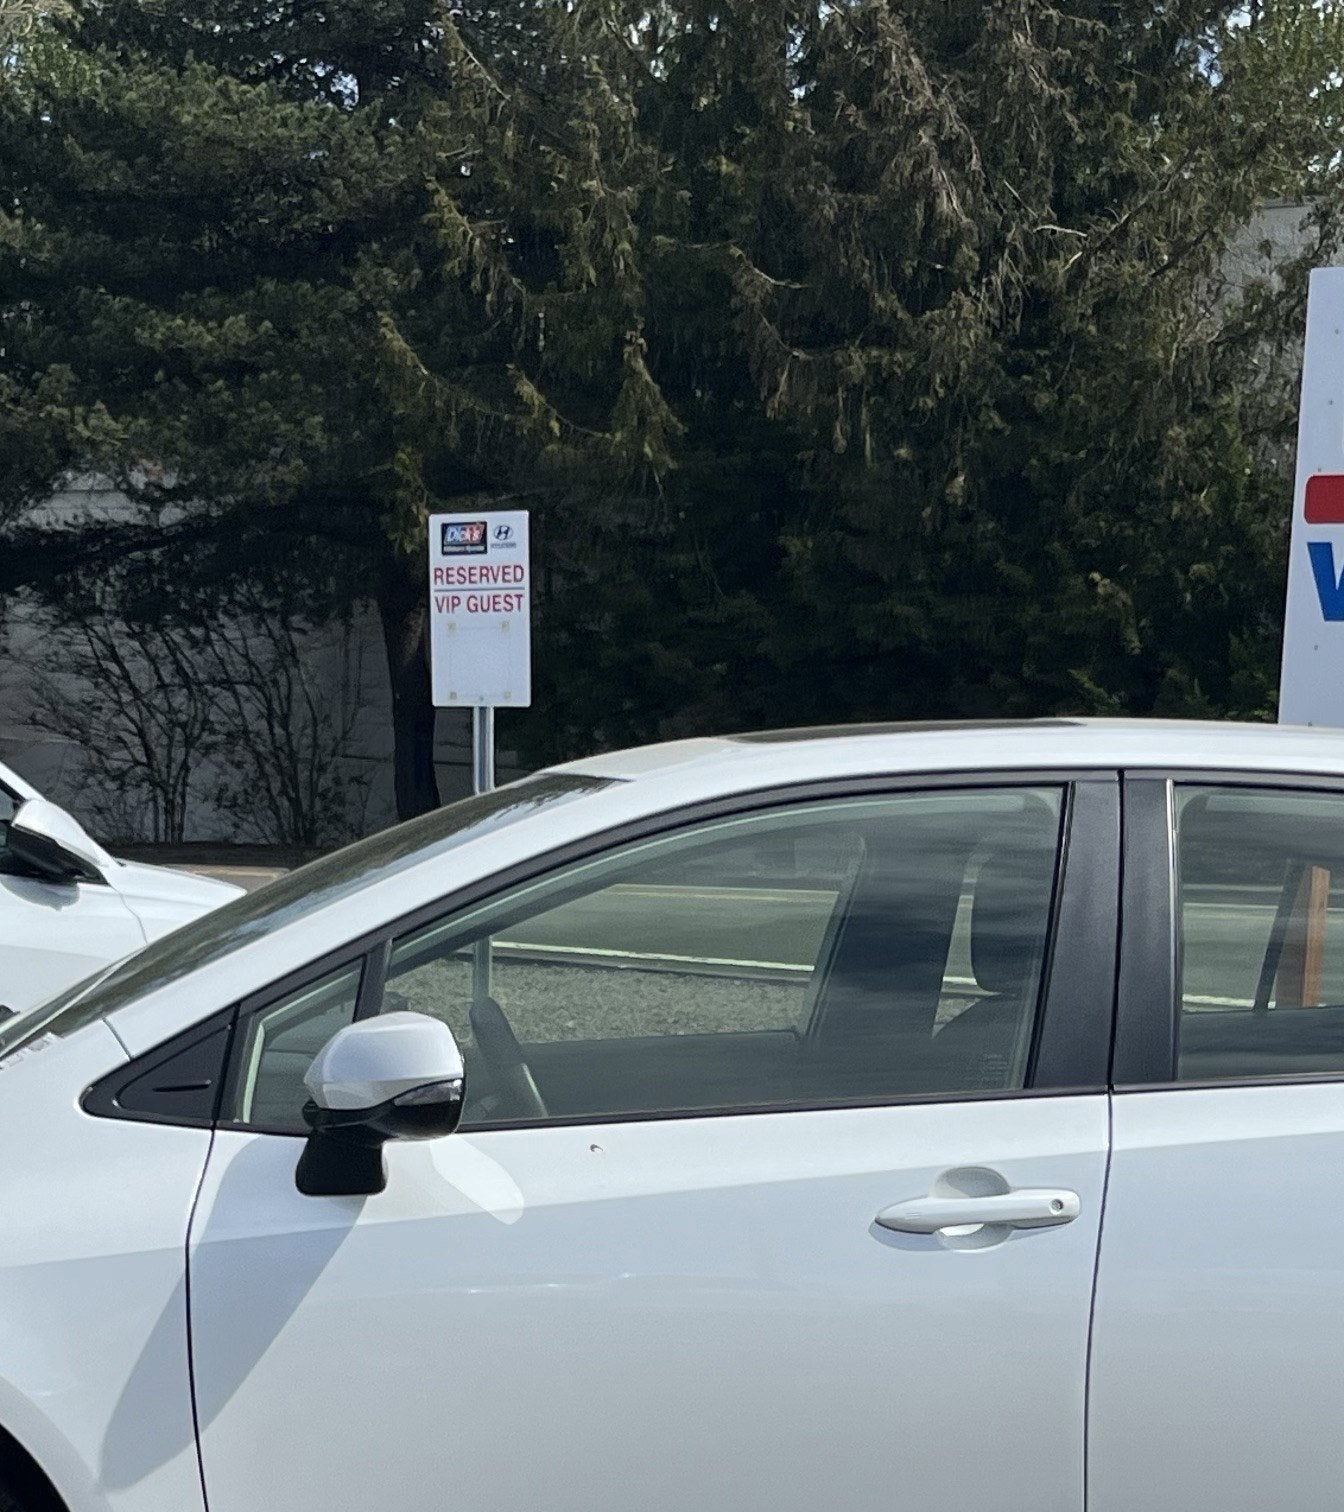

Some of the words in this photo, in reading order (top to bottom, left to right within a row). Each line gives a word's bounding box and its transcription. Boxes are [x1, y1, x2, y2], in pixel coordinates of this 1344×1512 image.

[434, 565, 525, 585] RESERVED
[435, 595, 461, 614] VIP
[466, 593, 524, 613] GUEST
